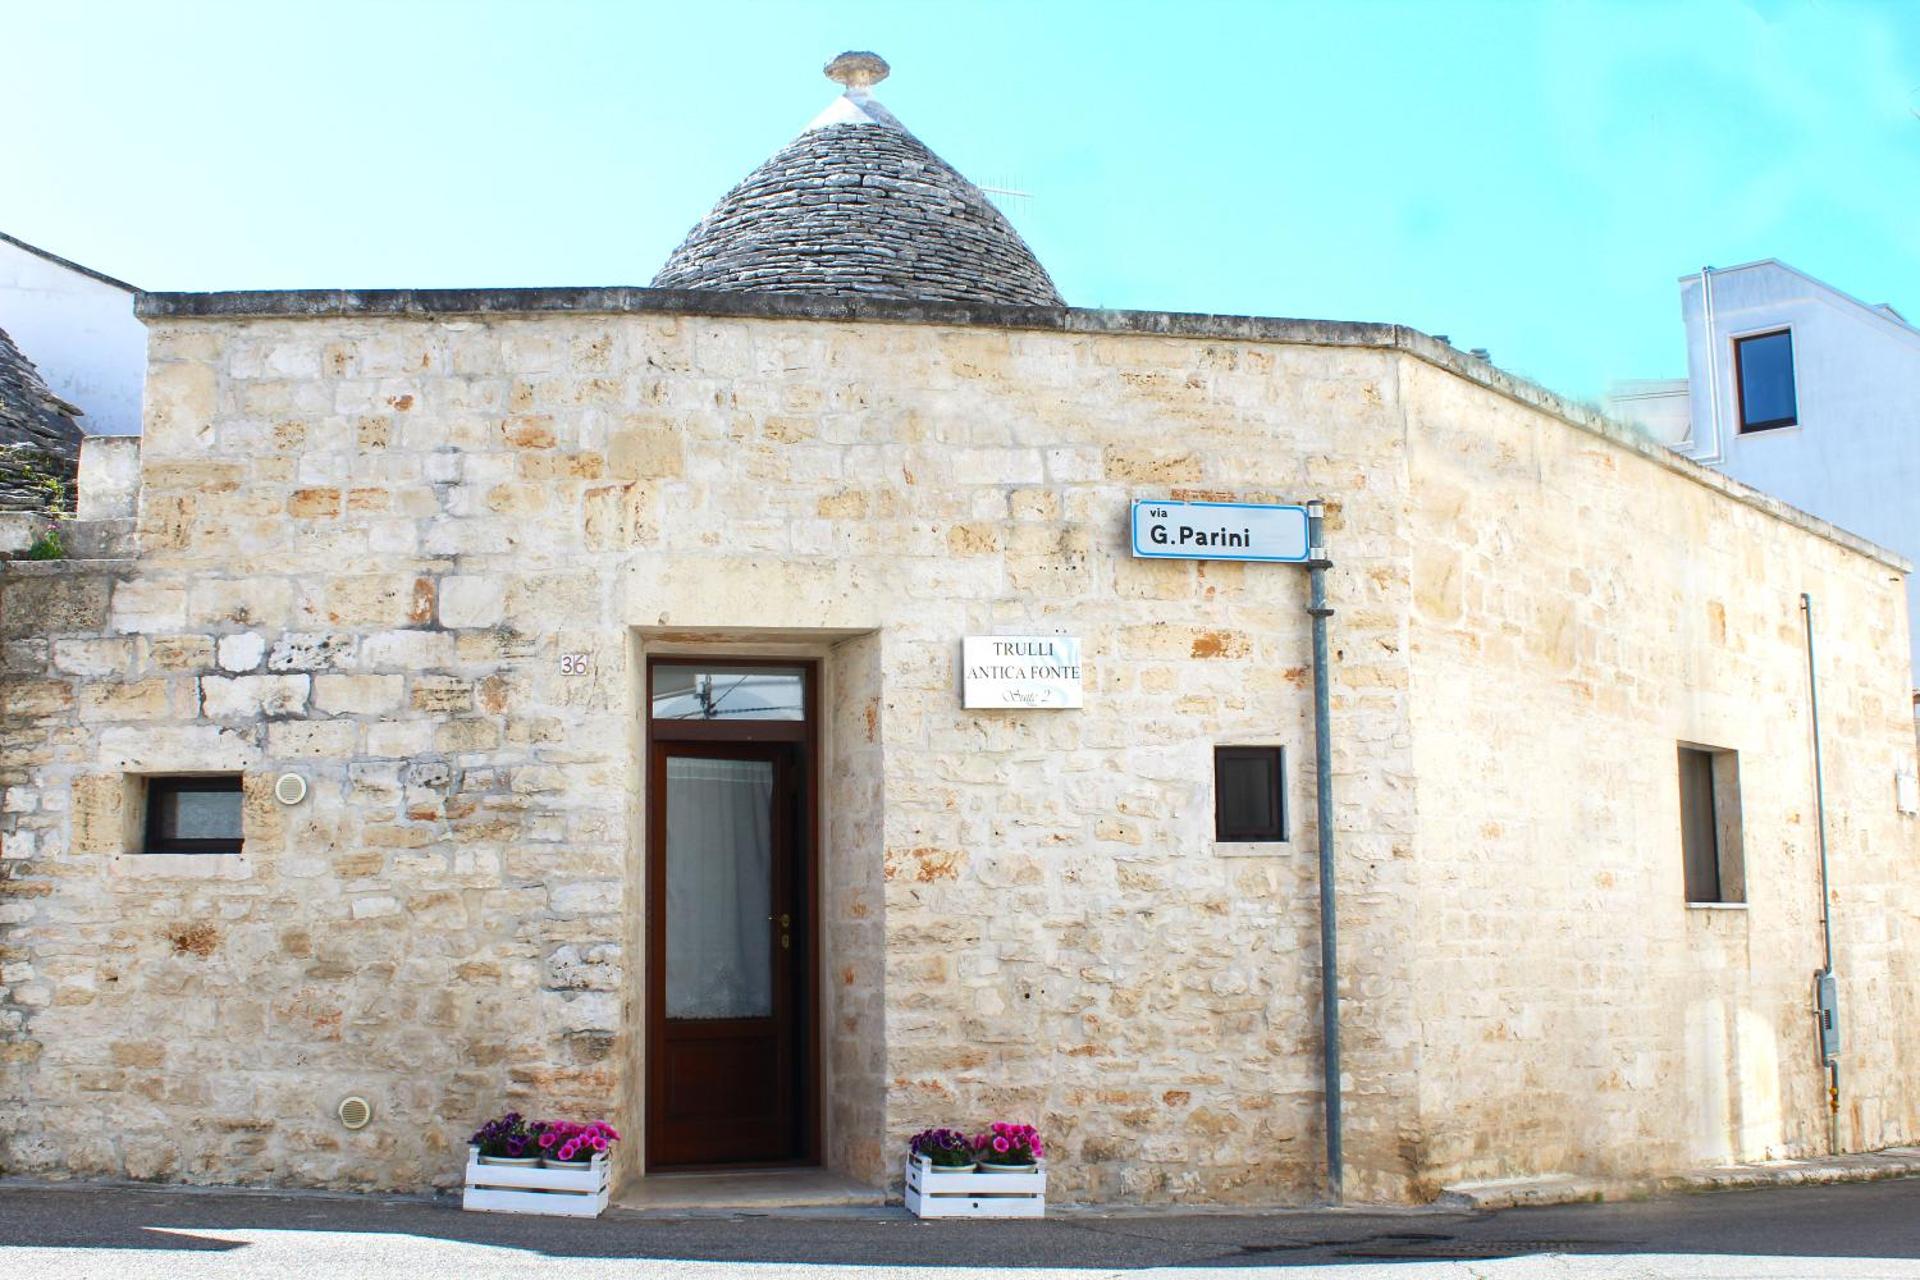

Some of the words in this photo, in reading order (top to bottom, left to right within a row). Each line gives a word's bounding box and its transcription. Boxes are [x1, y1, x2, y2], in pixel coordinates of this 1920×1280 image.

[1150, 508, 1168, 518] via
[993, 641, 1054, 656] TRULLI
[562, 655, 586, 674] 36
[967, 665, 1027, 680] ANTICA
[1031, 665, 1081, 680] FONTE
